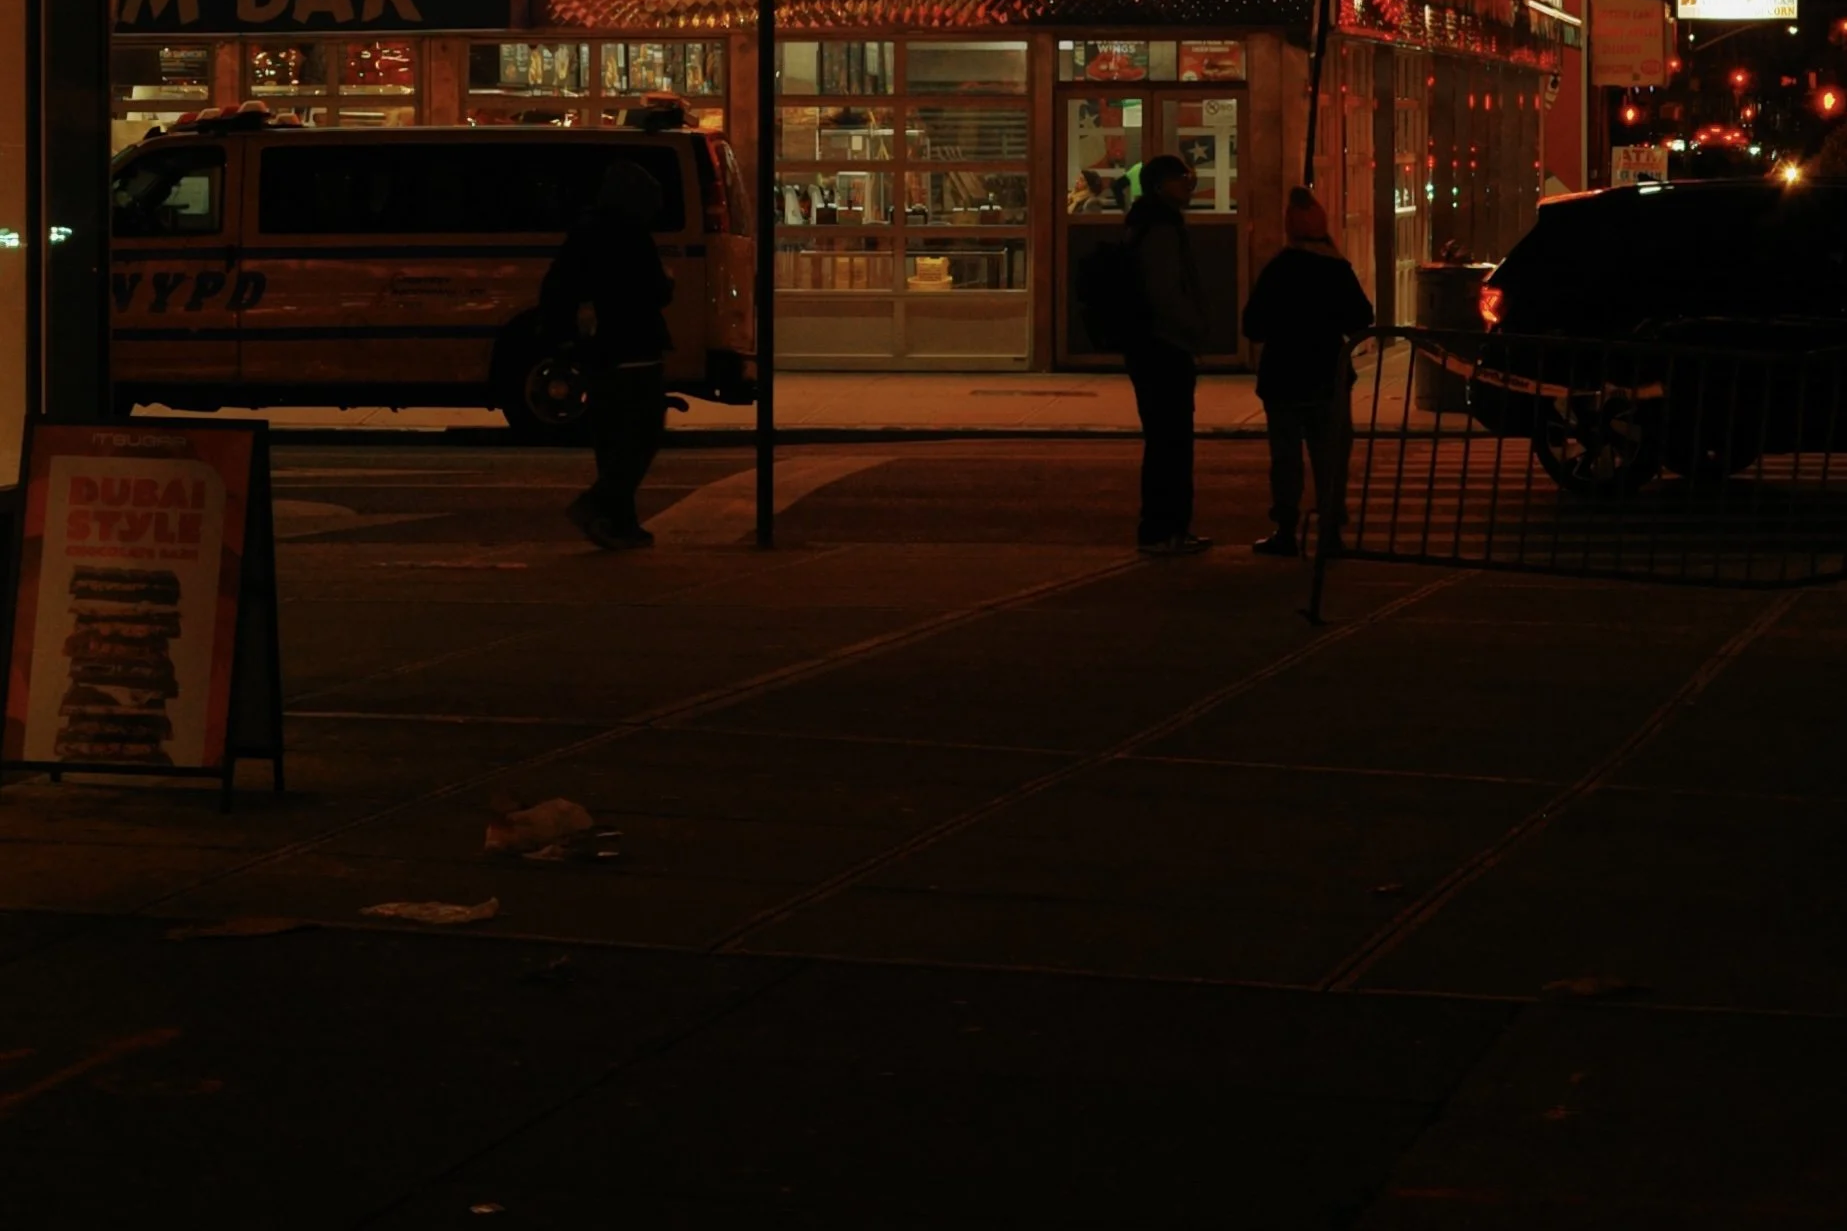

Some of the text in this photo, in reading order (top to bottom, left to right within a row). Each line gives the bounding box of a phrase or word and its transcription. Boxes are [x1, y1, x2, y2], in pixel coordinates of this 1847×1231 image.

[1097, 44, 1136, 54] WINGS
[68, 475, 205, 509] DUBAI
[65, 509, 202, 544] STYLE
